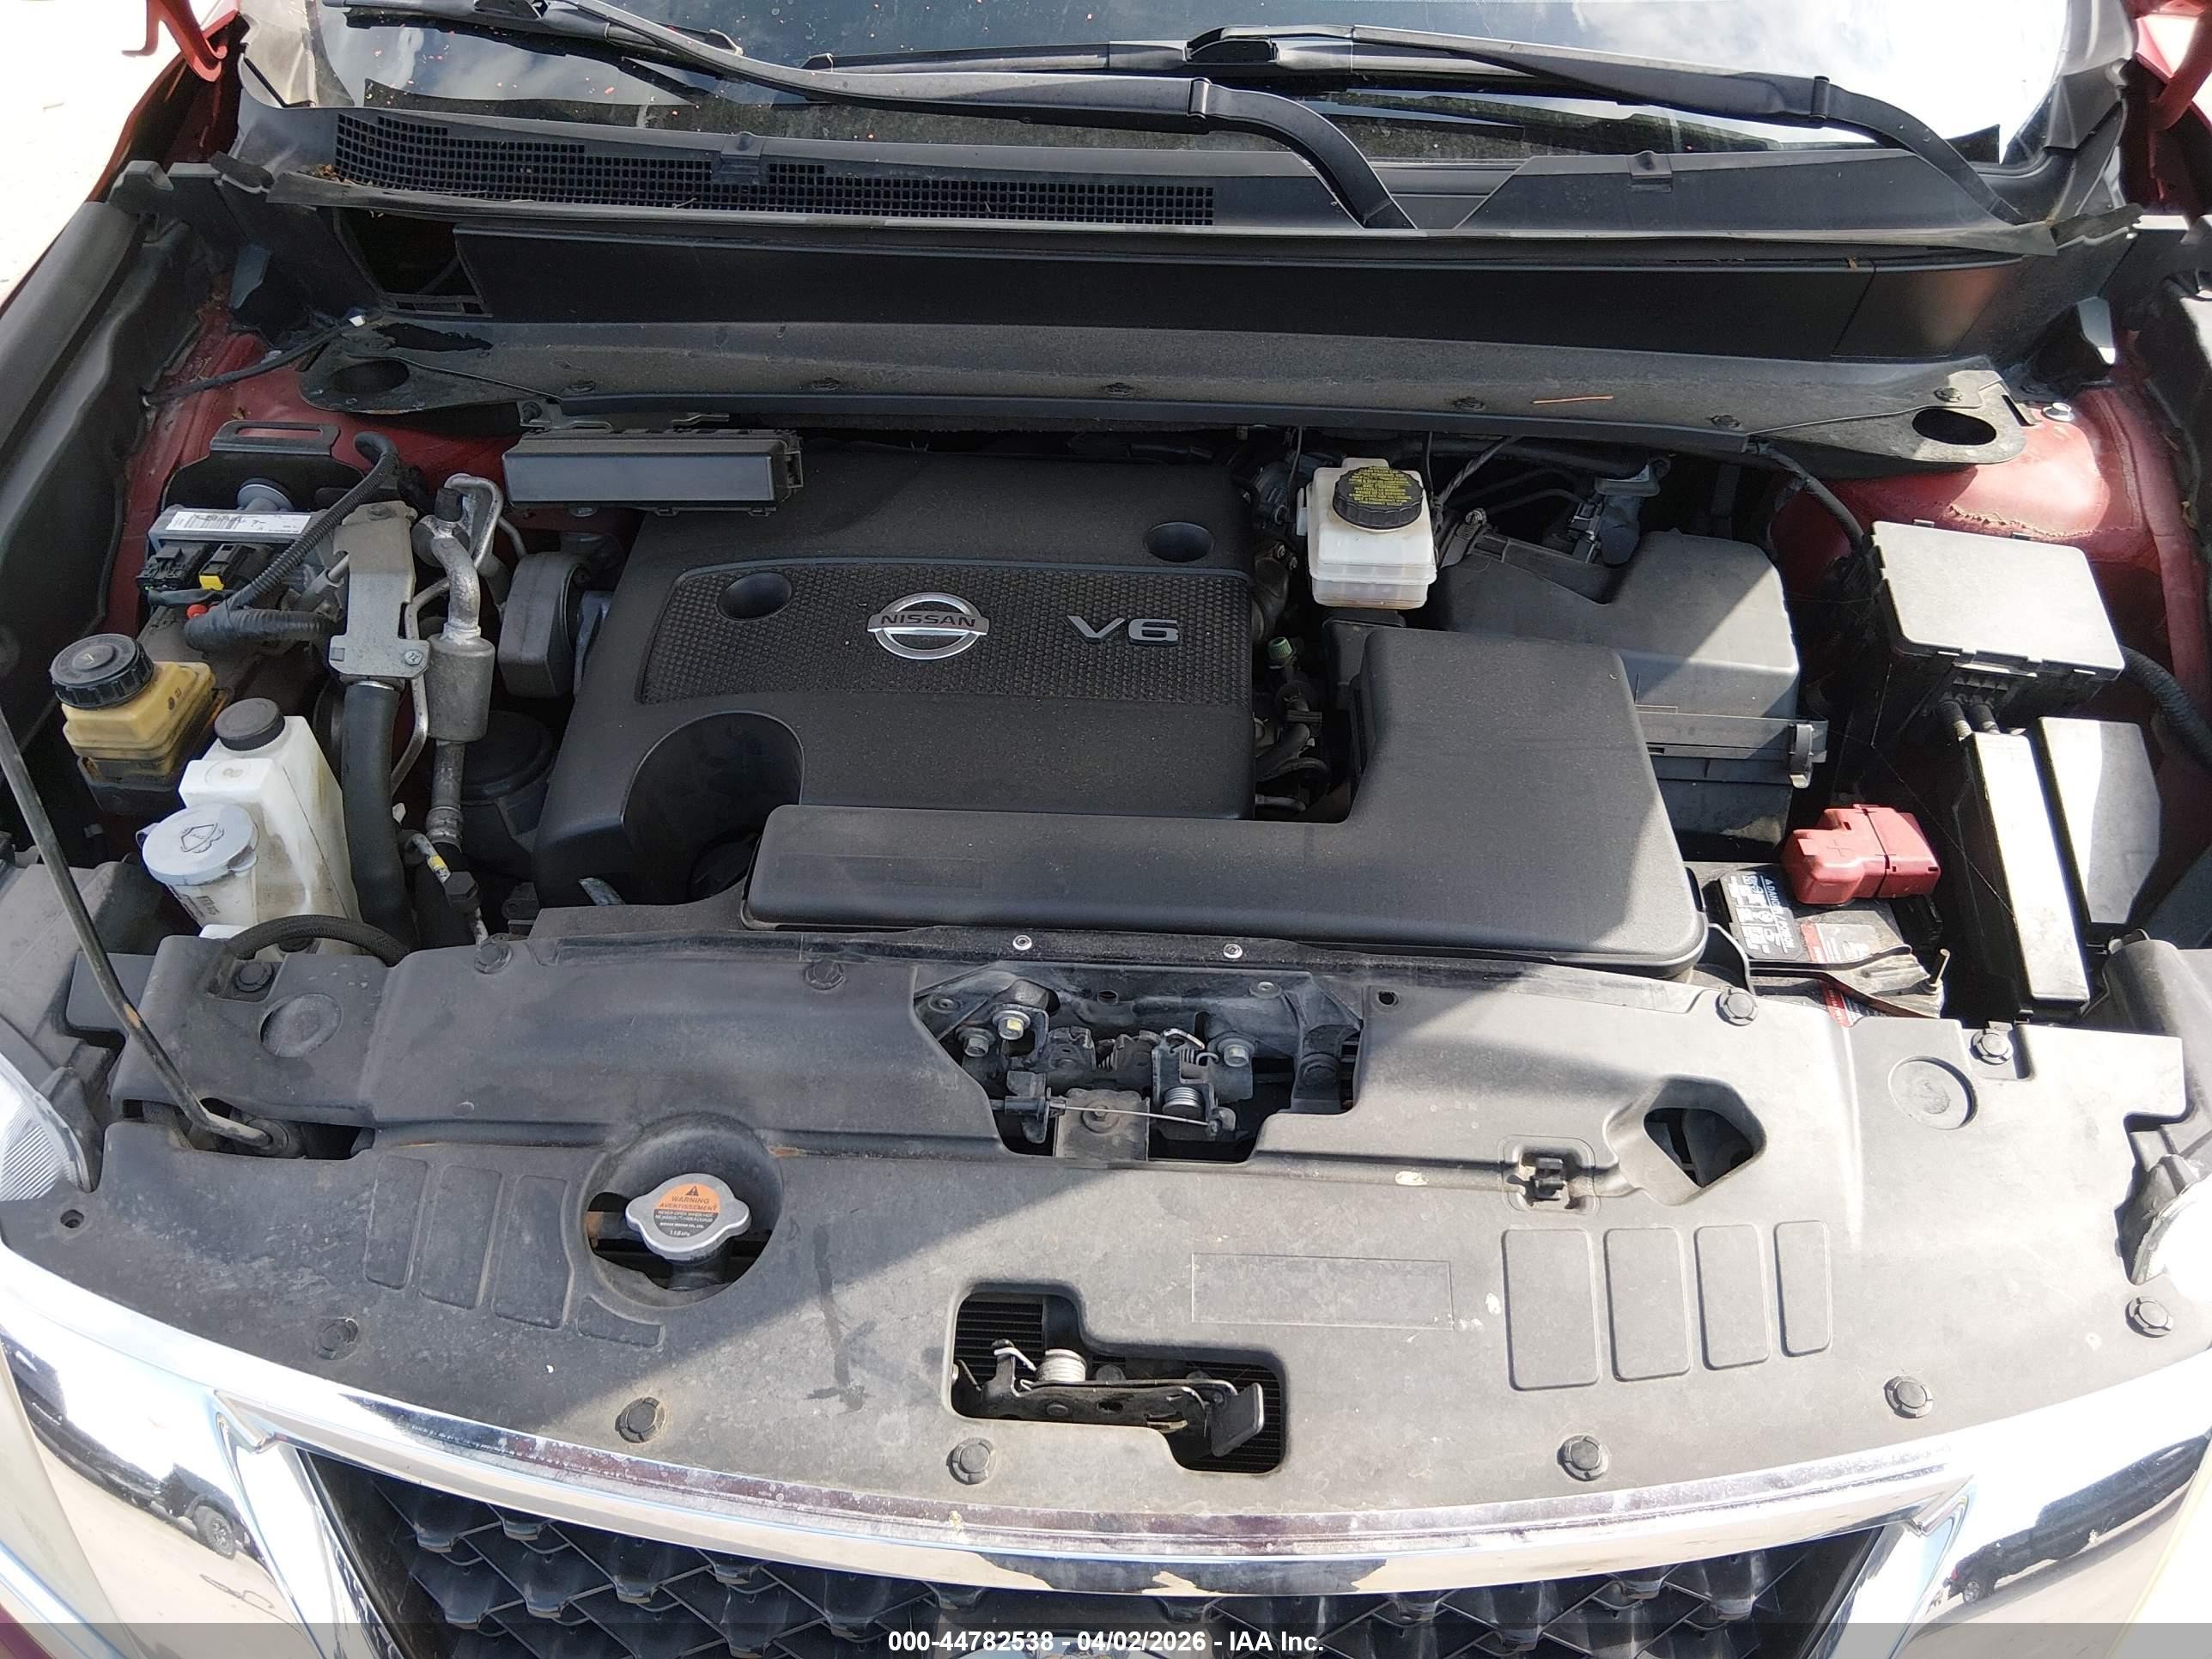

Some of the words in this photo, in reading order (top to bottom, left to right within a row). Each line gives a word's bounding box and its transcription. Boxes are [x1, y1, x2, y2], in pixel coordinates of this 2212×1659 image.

[880, 613, 975, 629] NISSAN
[1067, 615, 1179, 645] V6
[659, 1202, 717, 1211] AVERTISSEMENT
